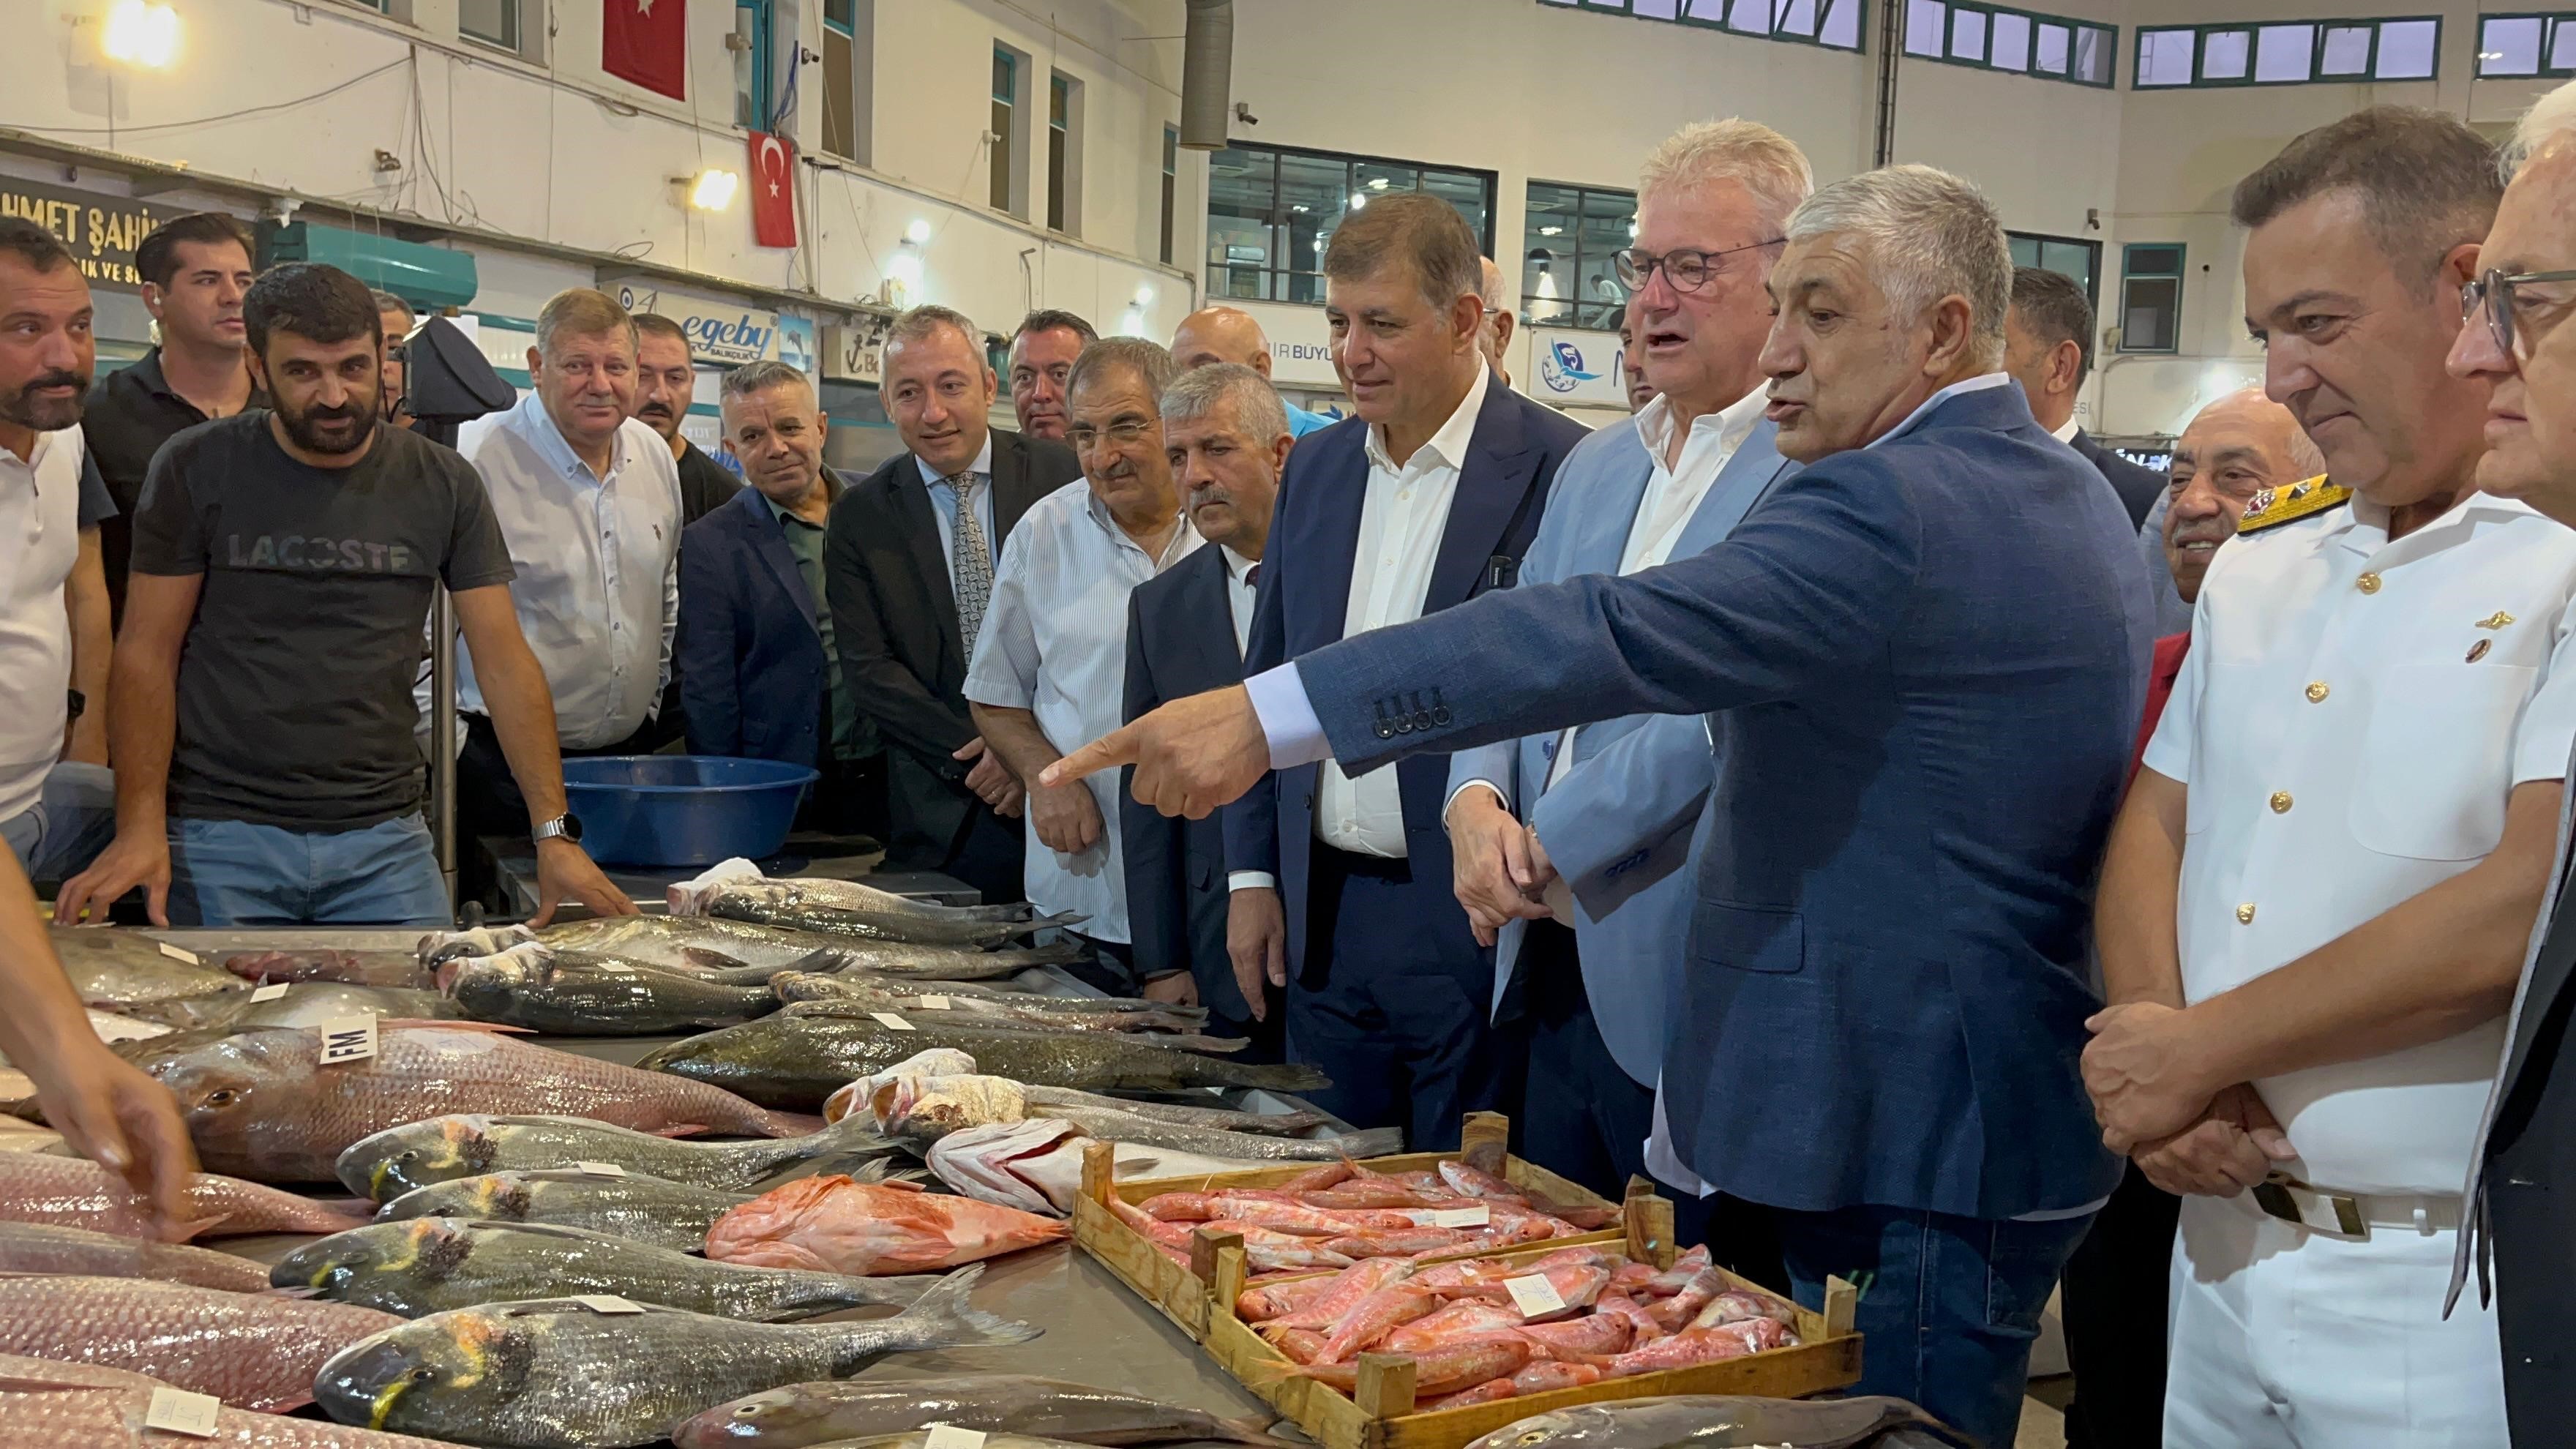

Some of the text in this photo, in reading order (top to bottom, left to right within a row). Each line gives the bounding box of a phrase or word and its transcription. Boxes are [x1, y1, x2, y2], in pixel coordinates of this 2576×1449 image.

[89, 208, 160, 256] ŞAHİ
[102, 261, 121, 282] VE
[682, 314, 773, 359] egeby
[228, 534, 411, 574] LACOSTE
[329, 1029, 367, 1058] FM
